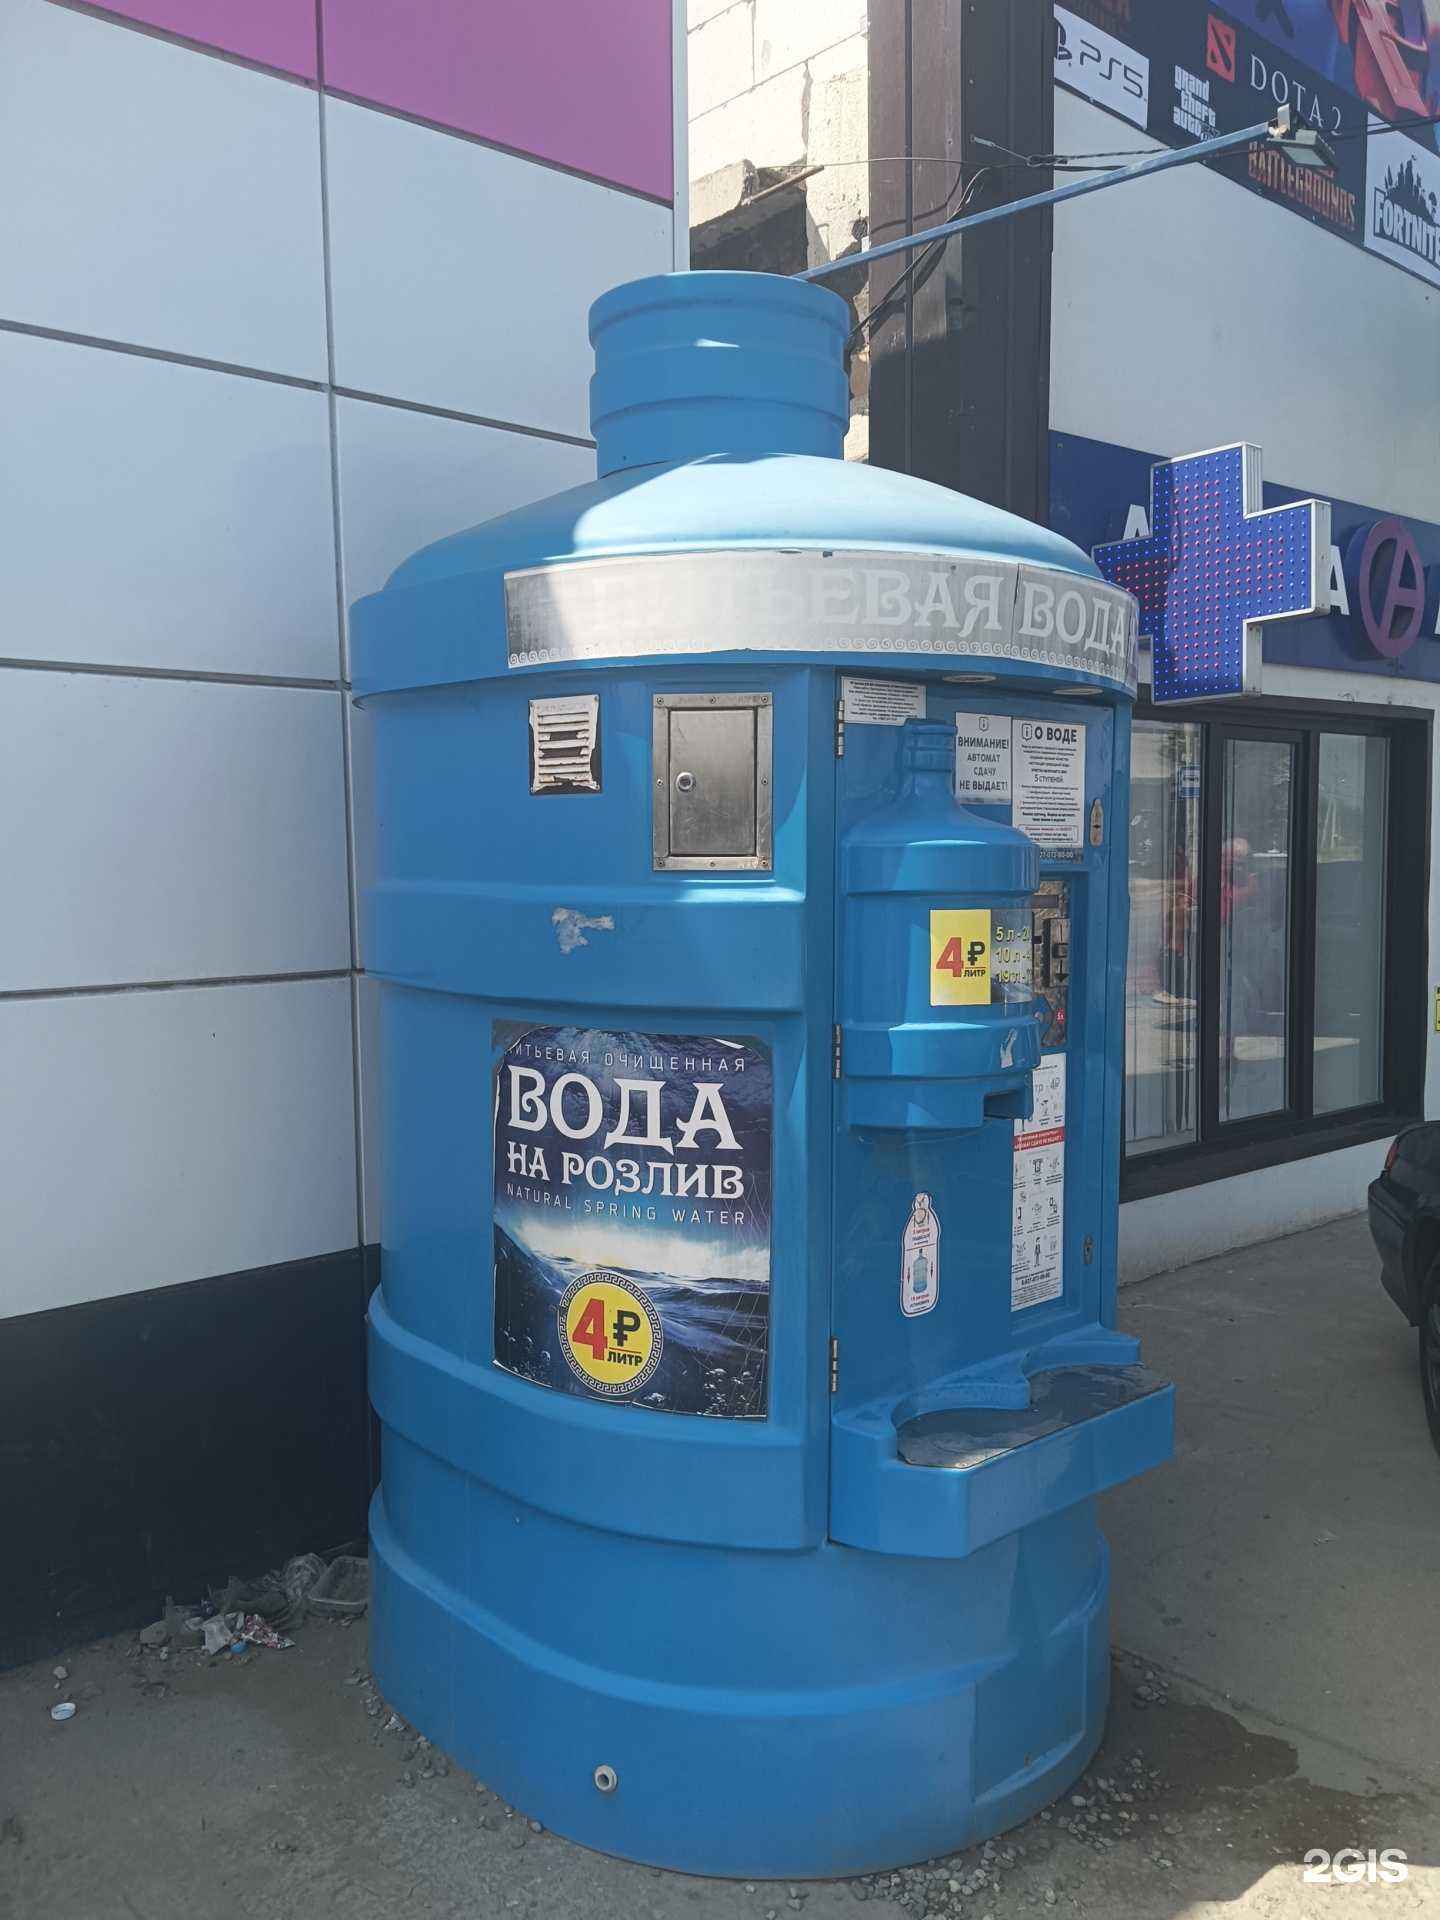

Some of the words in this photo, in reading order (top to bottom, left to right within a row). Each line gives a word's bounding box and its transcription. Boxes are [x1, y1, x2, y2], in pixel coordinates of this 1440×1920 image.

[1080, 39, 1144, 98] PS5
[1250, 54, 1325, 128] DOTA
[1331, 105, 1342, 136] 2
[1019, 580, 1126, 658] ВОДА
[957, 736, 1009, 750] ВНИМАНИЕ!
[1046, 727, 1077, 744] ВОДЕ
[967, 753, 1001, 763] АВТОМАТ
[973, 766, 997, 777] СДАЧУ
[959, 780, 971, 791] НЕ
[963, 967, 987, 978] ЛИТР
[508, 1041, 591, 1064] ИТЬЕВАЯ
[604, 1052, 745, 1073] ОЧИЩЕННАЯ
[507, 1064, 744, 1156] ВОДА
[507, 1140, 550, 1181] НА
[562, 1151, 745, 1200] РОЗЛИВ
[506, 1182, 572, 1210] NATURAL
[583, 1199, 657, 1221] SPRING
[672, 1210, 745, 1225] WATER
[607, 1351, 643, 1367] ЛИТР
